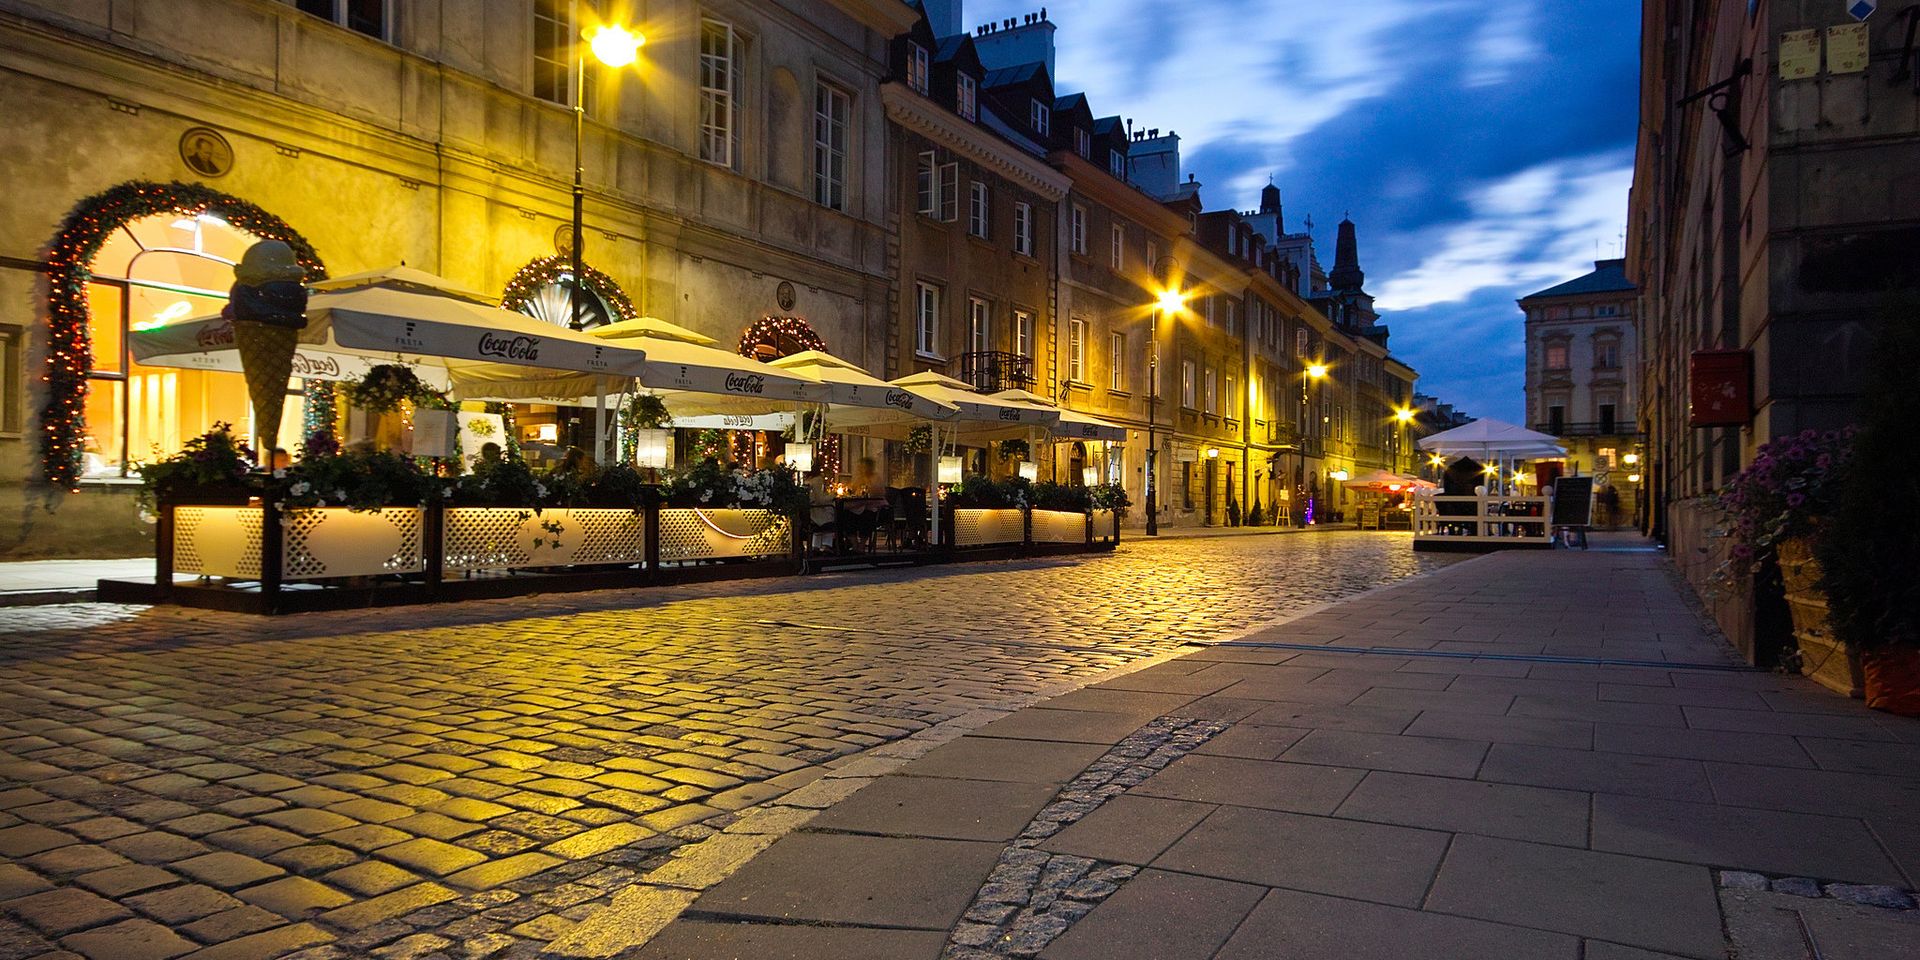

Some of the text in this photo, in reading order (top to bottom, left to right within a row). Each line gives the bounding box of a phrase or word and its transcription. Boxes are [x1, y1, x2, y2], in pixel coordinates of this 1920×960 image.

[478, 332, 540, 361] Coca-Cola
[725, 372, 764, 394] Coca-Cola
[885, 389, 913, 410] Coca-Cola
